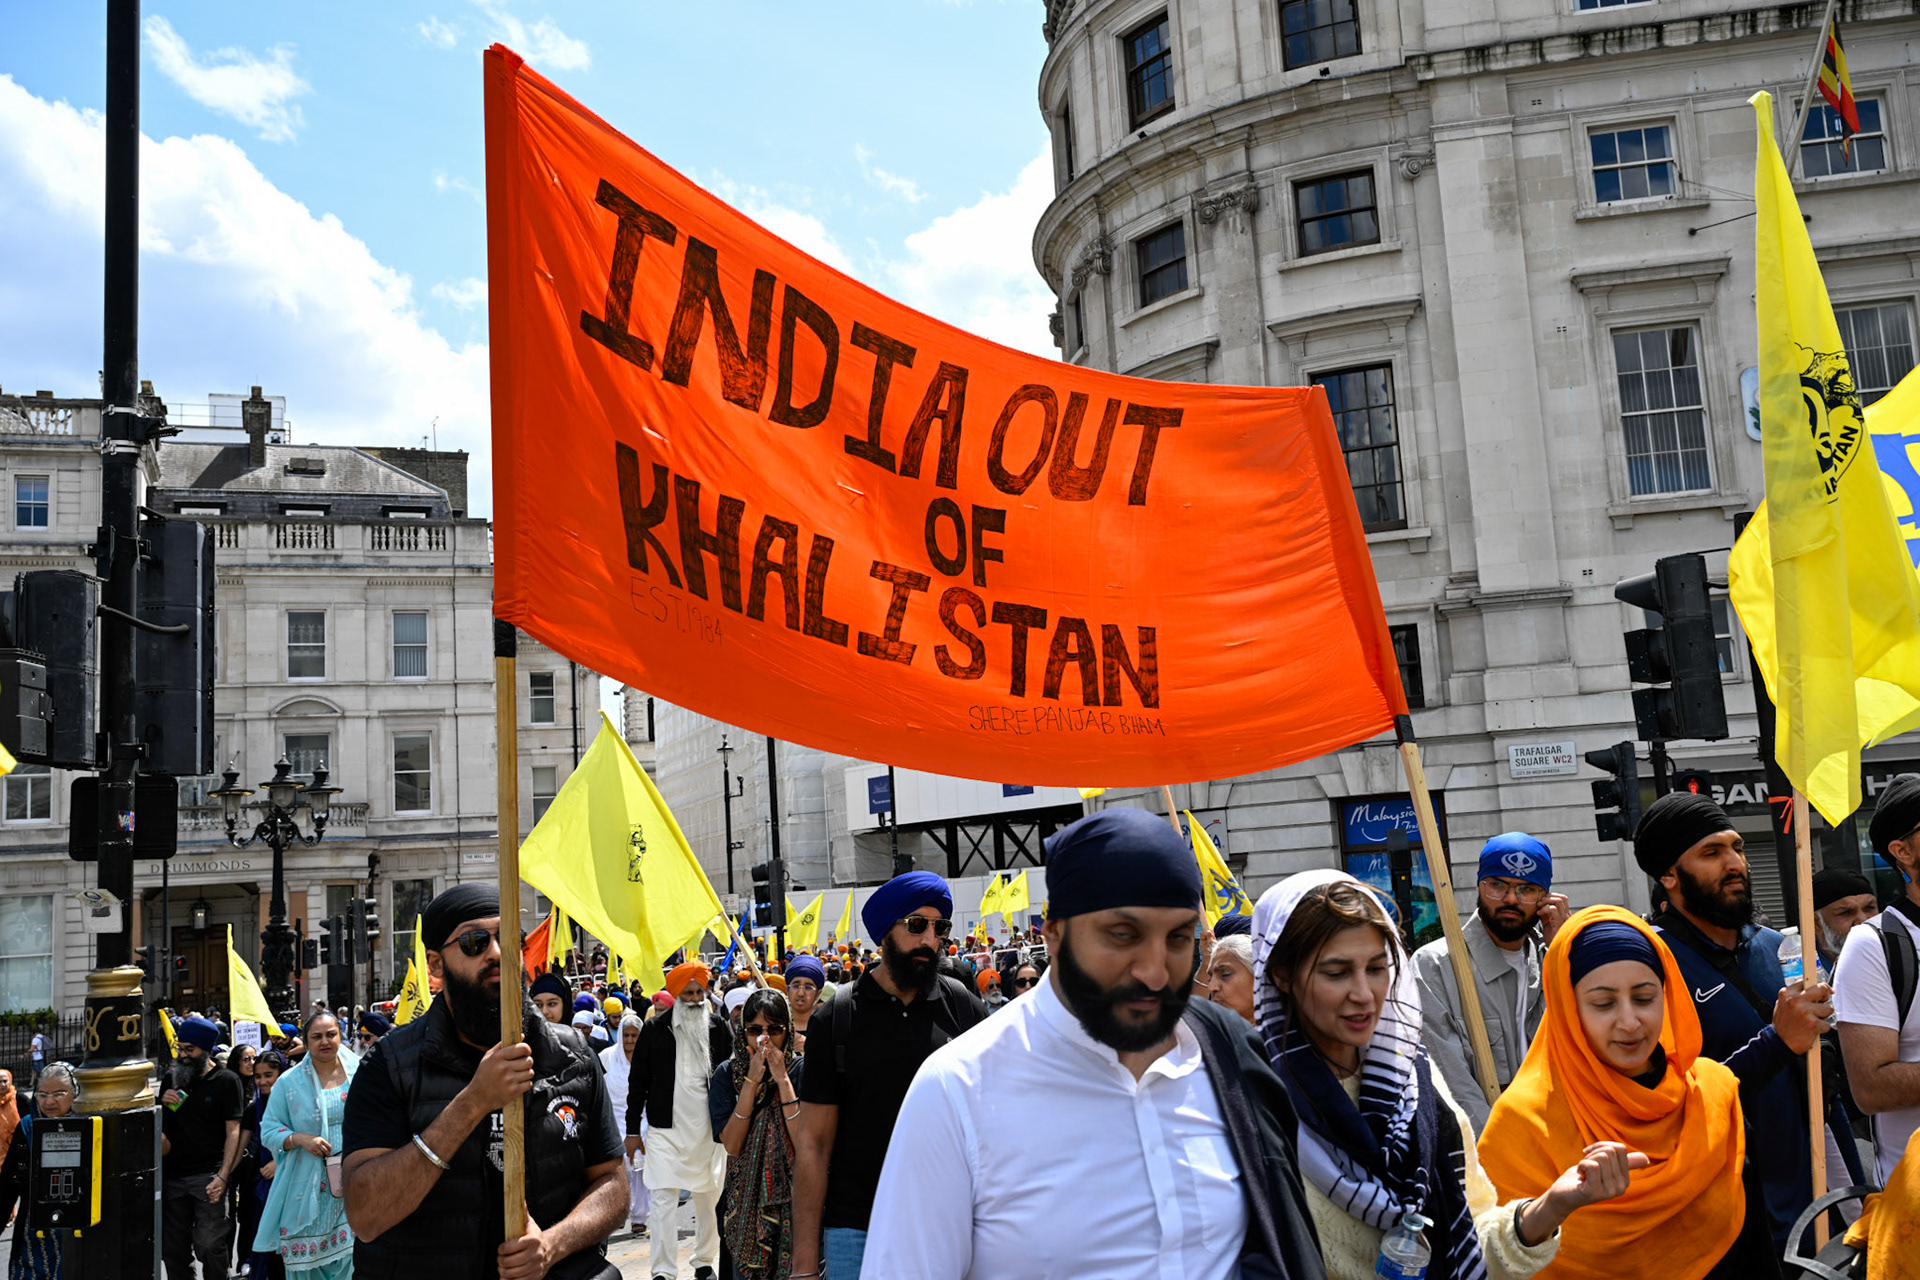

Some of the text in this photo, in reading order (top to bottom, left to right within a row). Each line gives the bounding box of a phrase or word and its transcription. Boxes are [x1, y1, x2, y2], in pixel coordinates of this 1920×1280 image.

[580, 178, 1184, 506] INDIA OUT
[924, 497, 1007, 588] OF
[615, 440, 1160, 709] KHALISTAN
[968, 705, 1166, 736] SHERE PANJAB B'HAM
[1514, 746, 1562, 756] TRAFALGAR
[1515, 755, 1572, 766] SQUARE WC2
